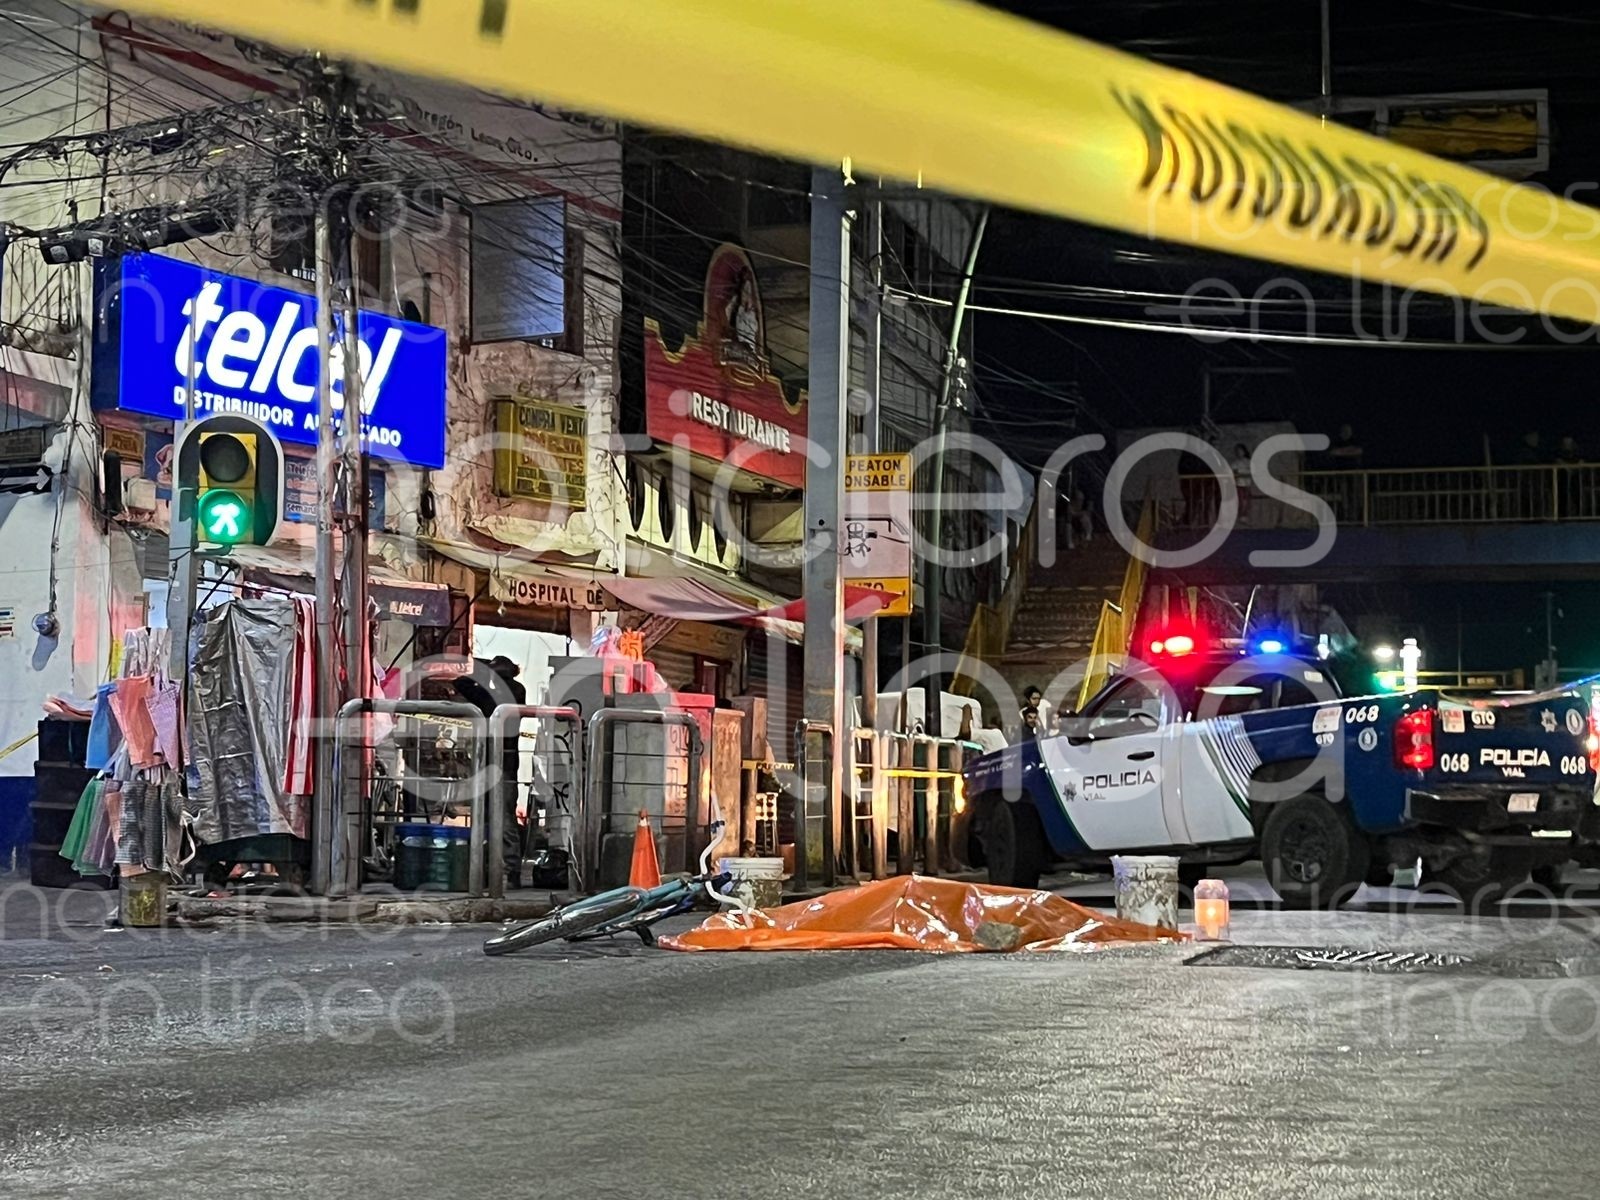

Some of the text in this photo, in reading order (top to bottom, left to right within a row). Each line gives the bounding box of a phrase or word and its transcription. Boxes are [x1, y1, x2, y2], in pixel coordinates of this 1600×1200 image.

[692, 392, 791, 454] RESTAURANTE
[849, 459, 901, 473] PEATON
[509, 580, 604, 605] HOSPITAL DE
[1345, 704, 1379, 724] 068
[1471, 711, 1496, 726] GTO
[1440, 747, 1586, 775] 068 POLICÍA 068
[1082, 769, 1156, 791] POLICÍA
[1501, 767, 1526, 778] VIAL
